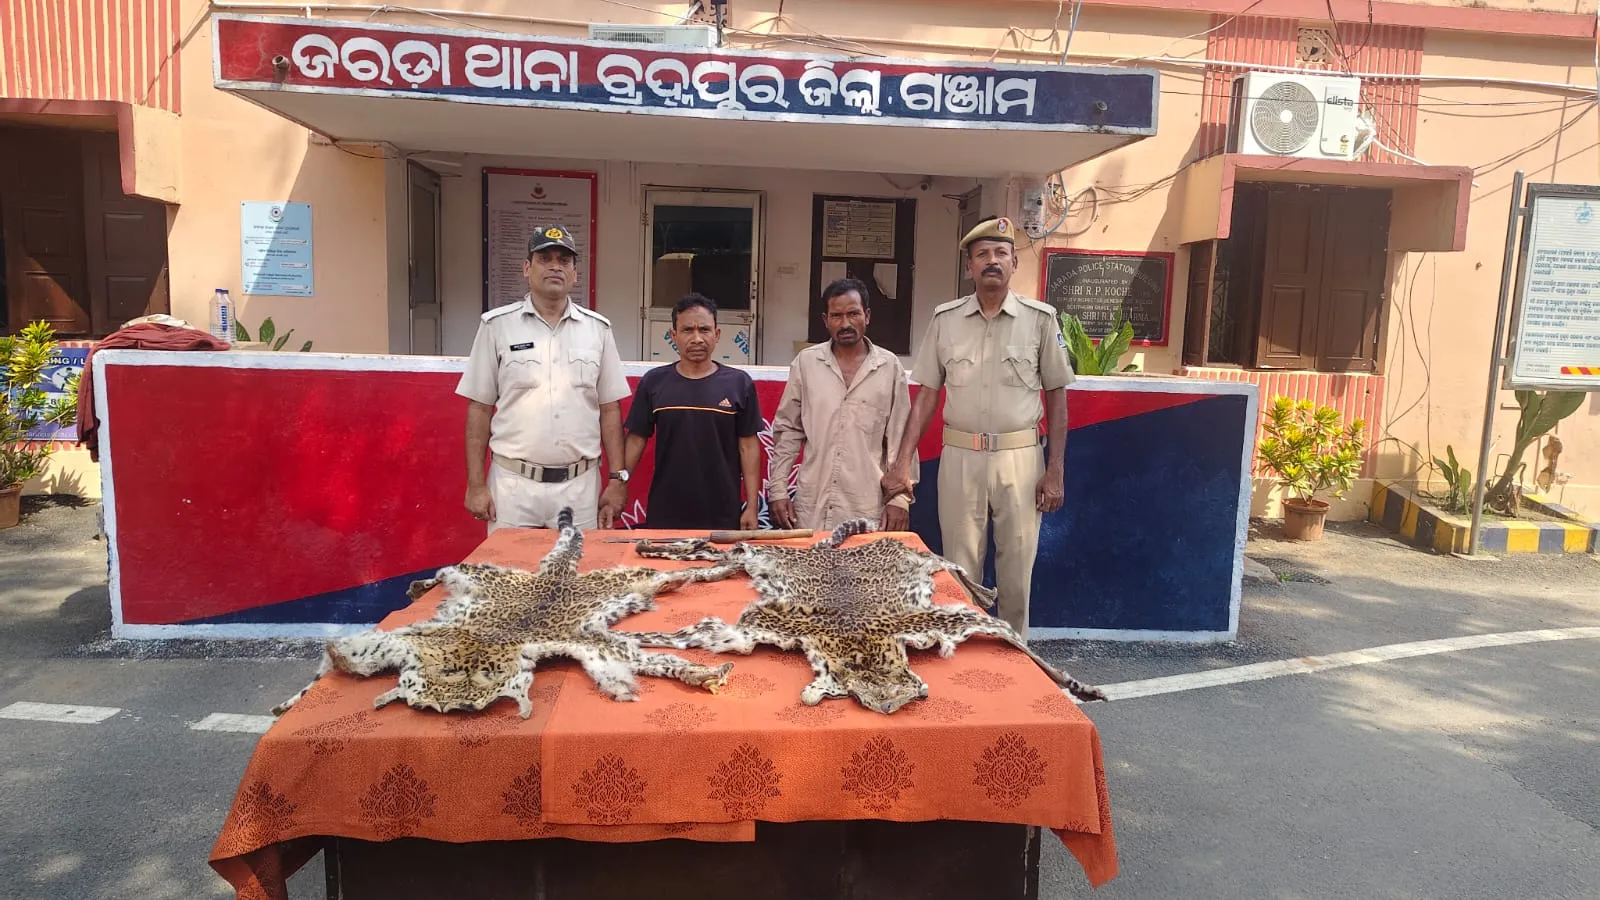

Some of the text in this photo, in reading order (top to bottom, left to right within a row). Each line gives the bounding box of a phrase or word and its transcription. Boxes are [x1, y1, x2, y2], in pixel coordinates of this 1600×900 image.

[291, 33, 450, 89] ଜରଡ଼ା
[465, 43, 578, 93] ଥାନା
[900, 72, 1036, 116] ଗଞ୍ଜାମ
[1050, 262, 1135, 292] JARADA POLICE STATION
[1062, 285, 1083, 295] SHRI
[1082, 311, 1100, 321] SHRI
